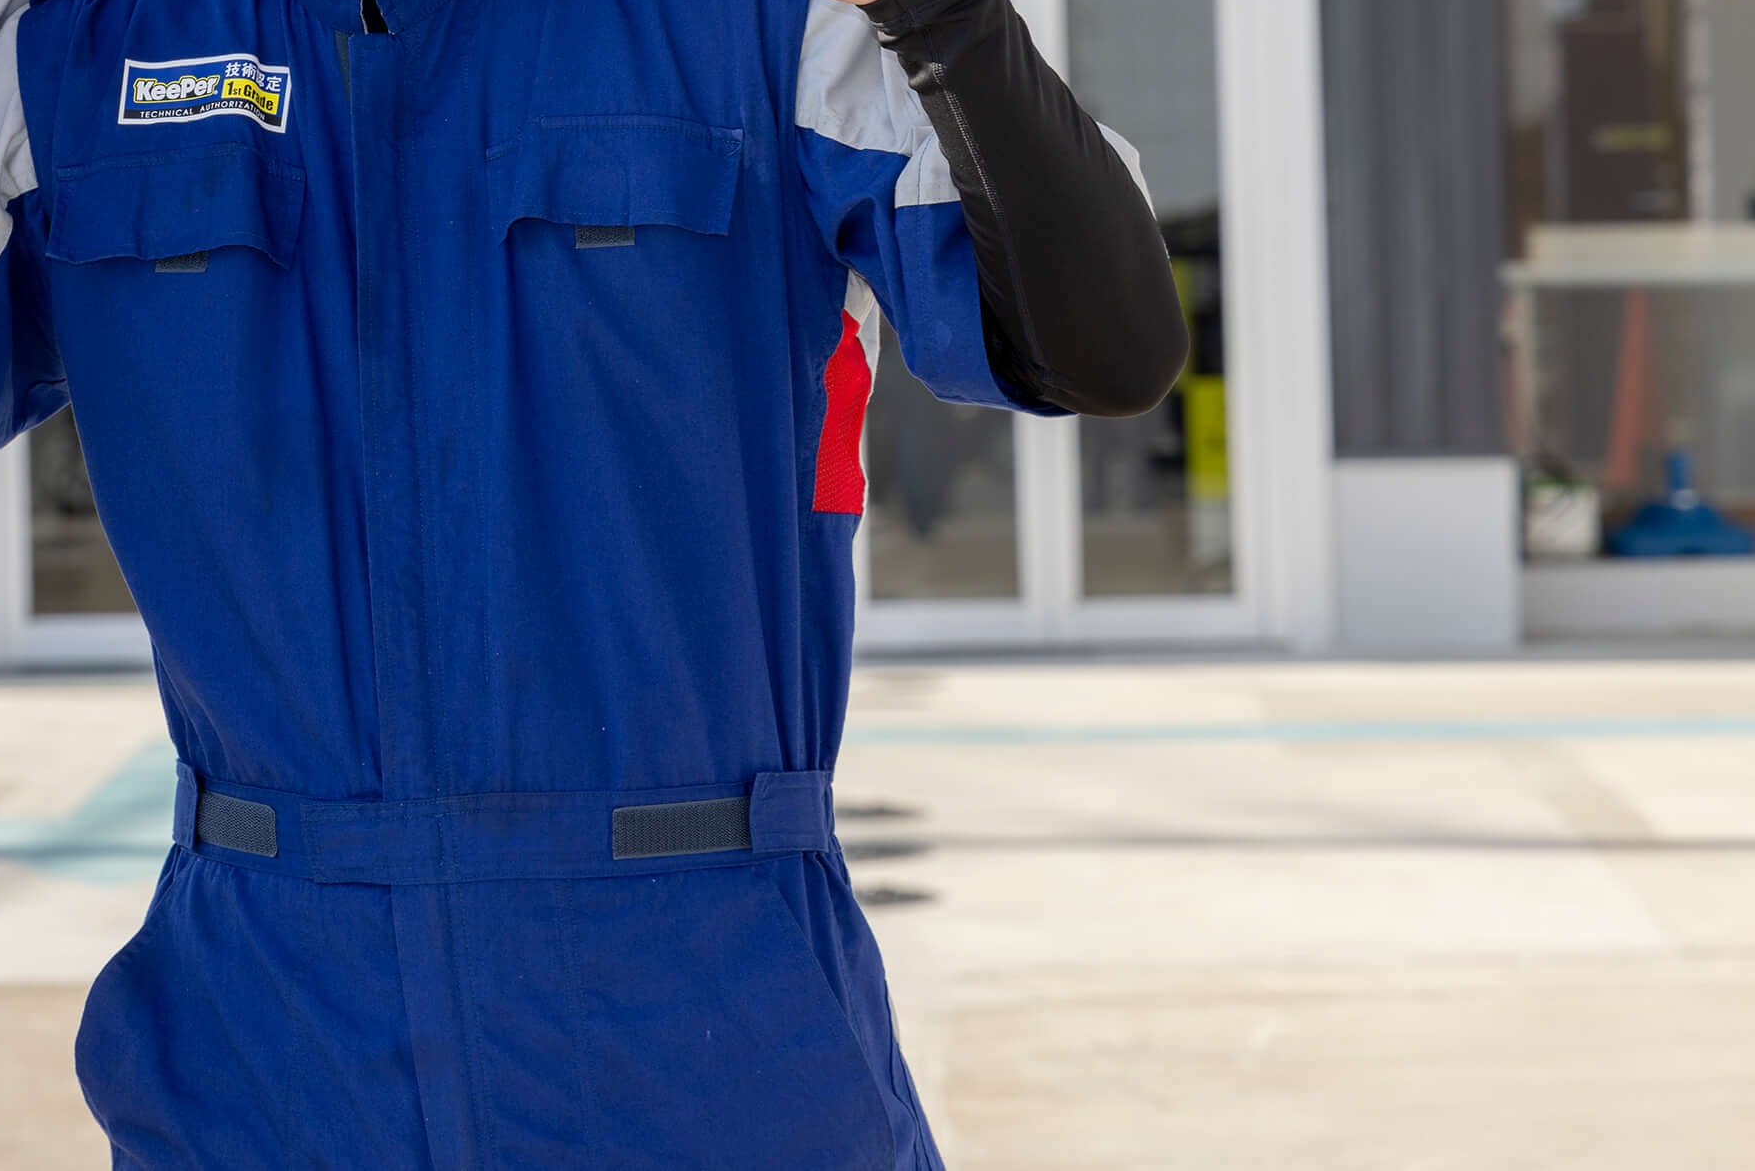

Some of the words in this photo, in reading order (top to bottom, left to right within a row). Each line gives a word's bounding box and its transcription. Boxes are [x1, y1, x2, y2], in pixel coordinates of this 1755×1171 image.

[135, 77, 219, 102] KeePer
[140, 109, 193, 119] TECHNICAL
[200, 100, 266, 121] AUTHORIZATION
